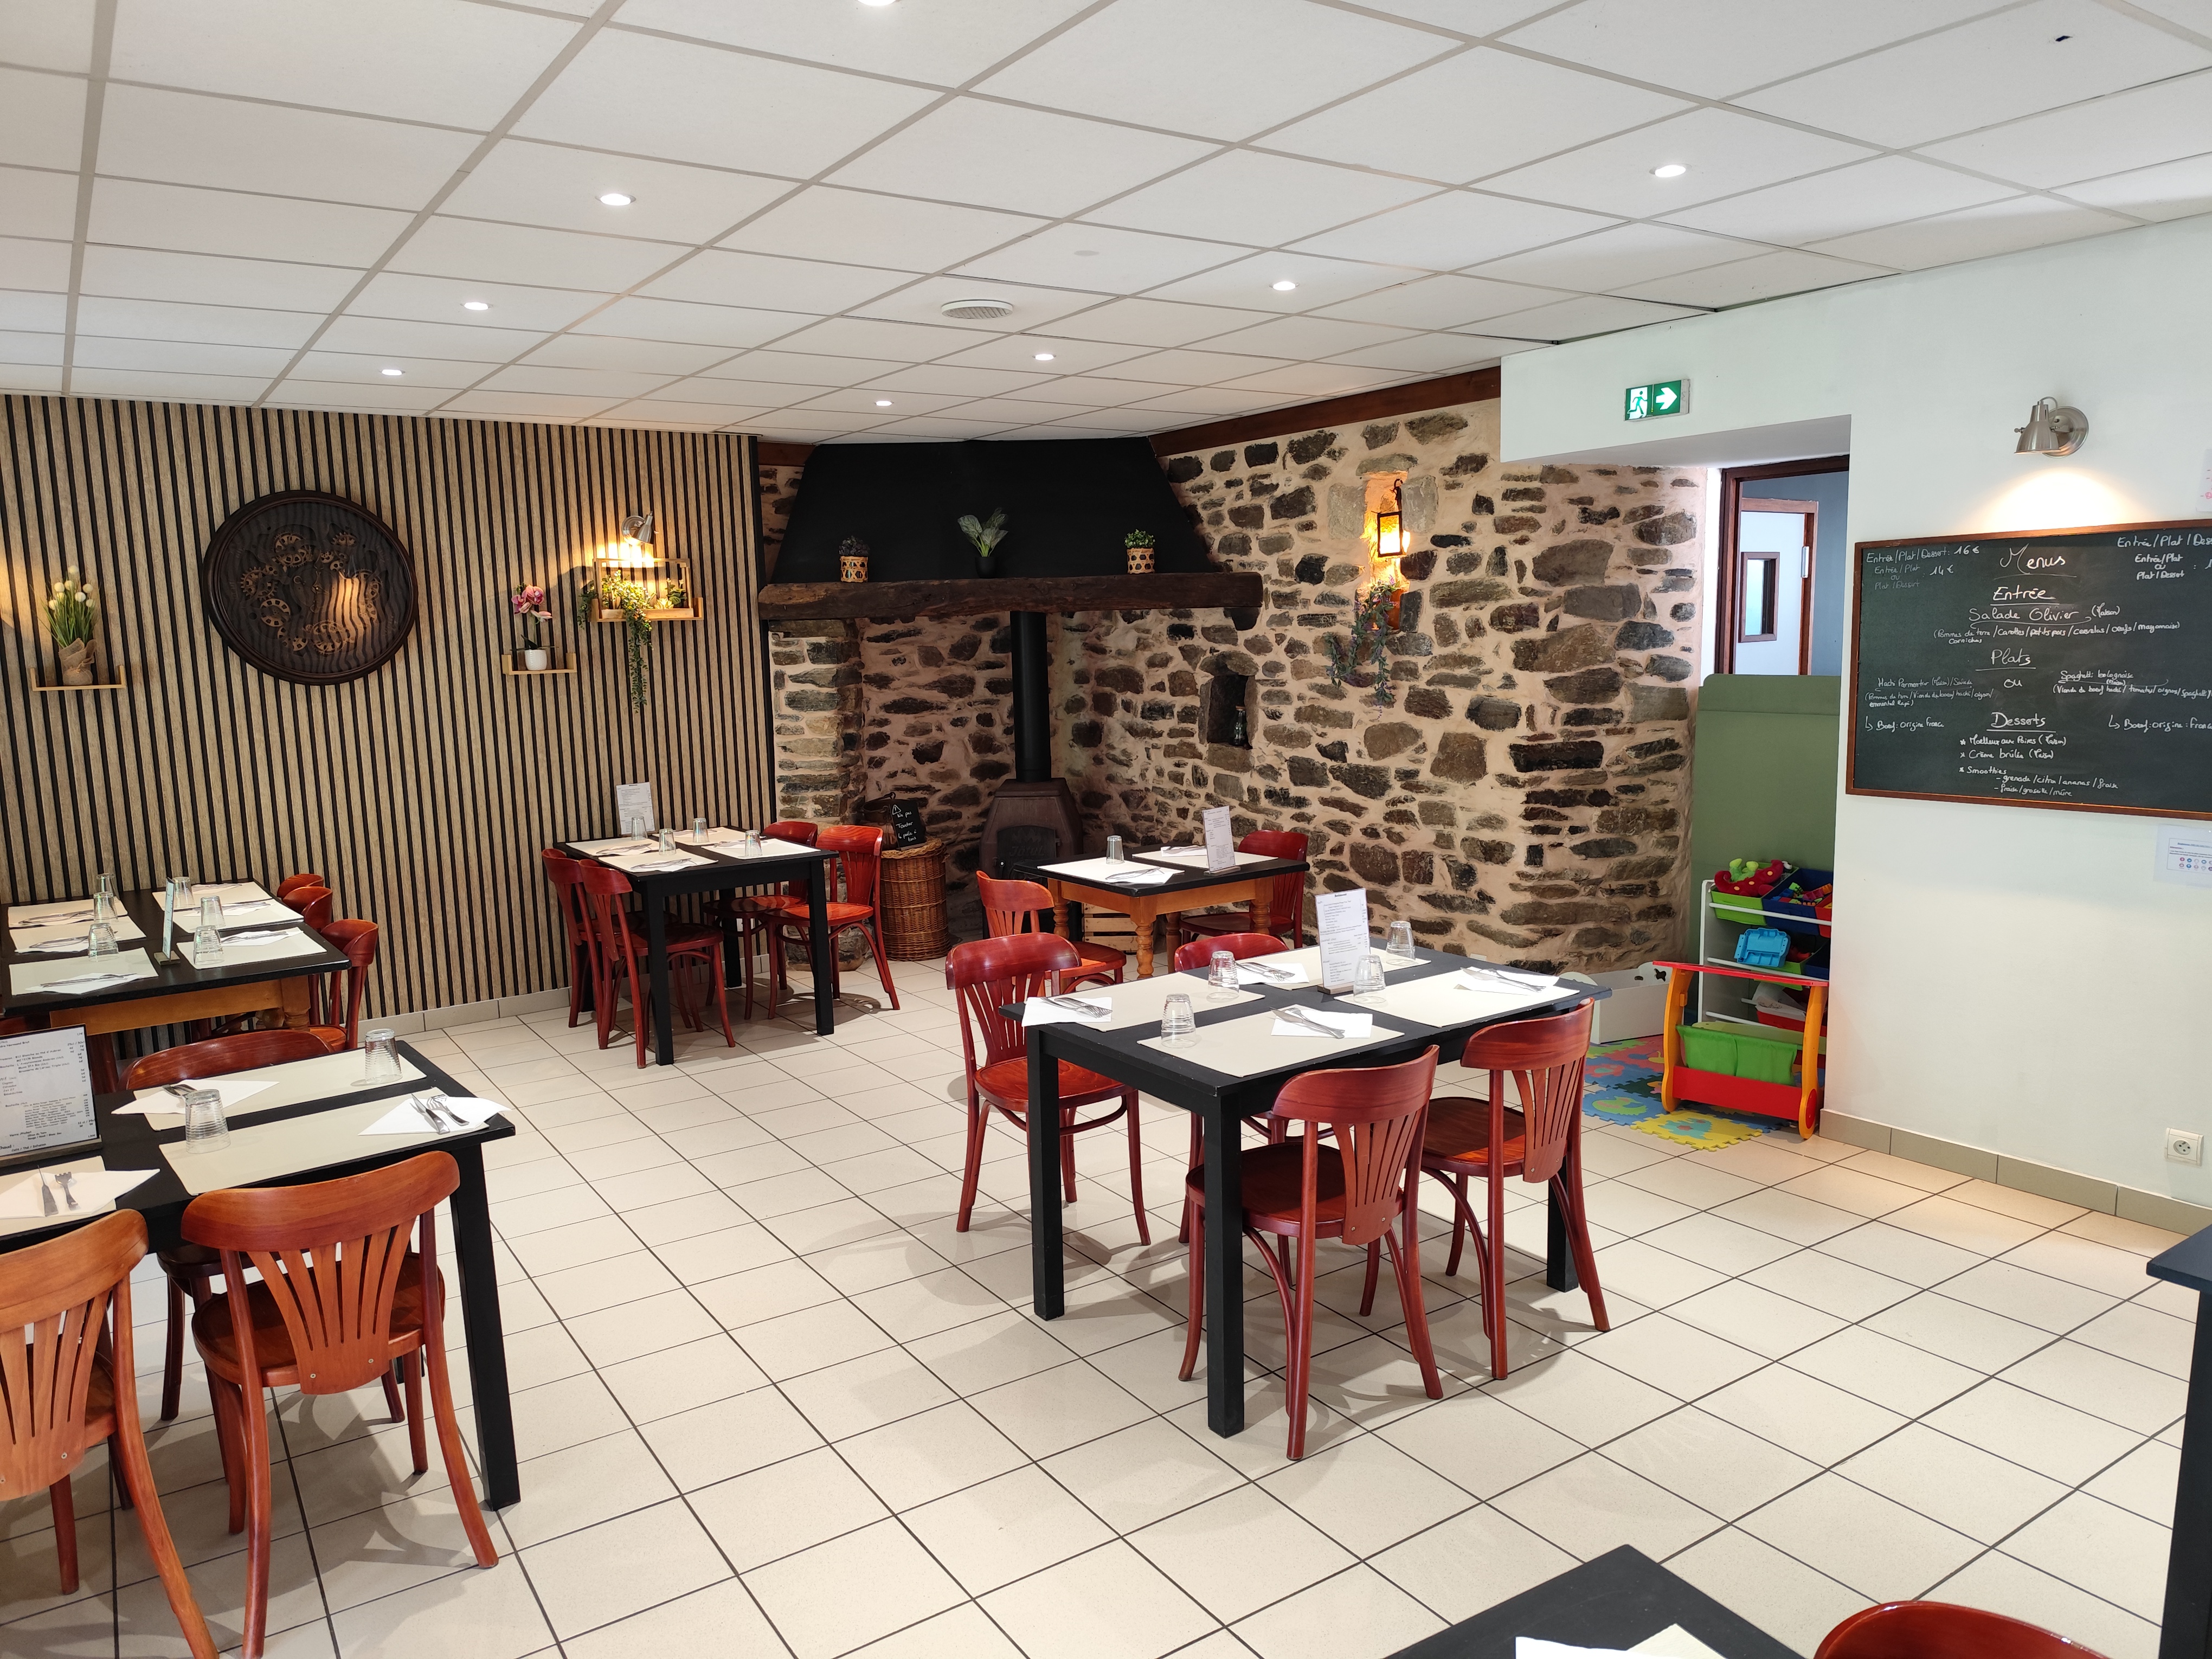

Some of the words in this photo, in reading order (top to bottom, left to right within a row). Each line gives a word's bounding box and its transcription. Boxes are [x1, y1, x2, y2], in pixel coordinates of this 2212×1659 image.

[1954, 545, 1970, 555] 16
[1999, 543, 2066, 575] Menus
[1929, 566, 1944, 576] 14
[1992, 584, 2056, 601] Entrée
[1968, 608, 2021, 621] Salade
[2029, 607, 2080, 622] Olivier
[1991, 647, 2031, 666] Plats
[1990, 712, 2046, 728] Desserts
[1966, 766, 2007, 775] Smoothies
